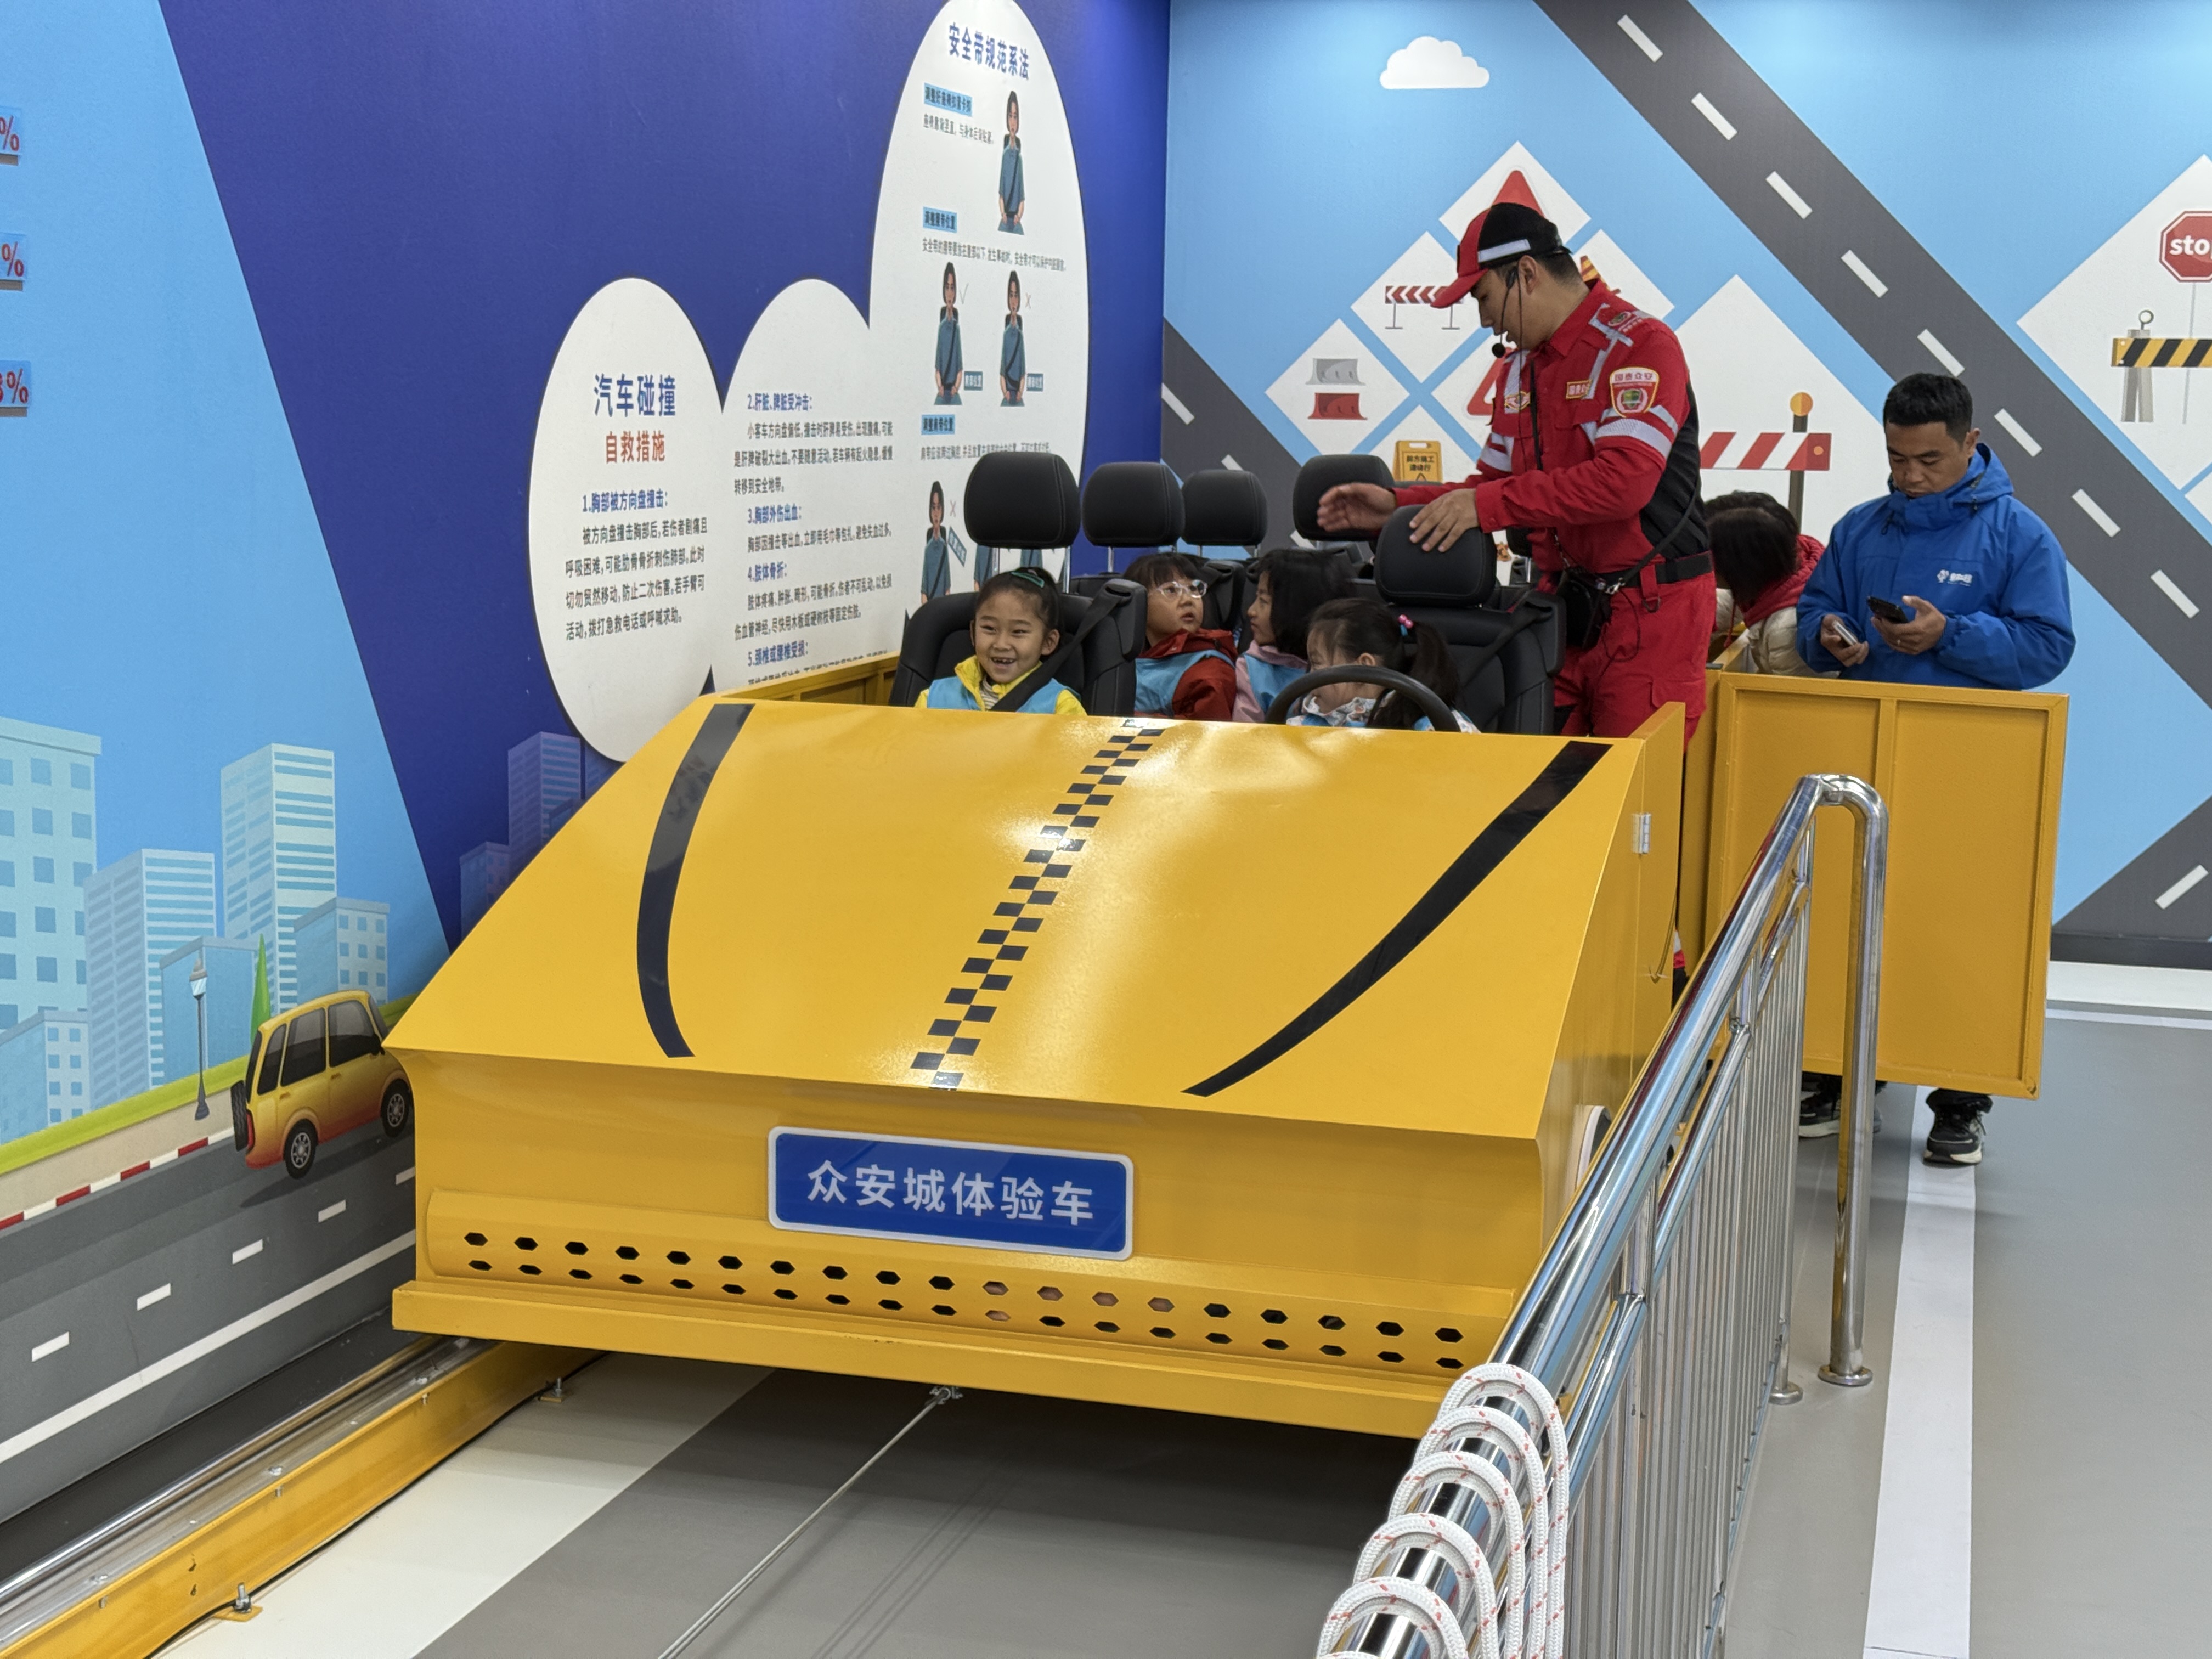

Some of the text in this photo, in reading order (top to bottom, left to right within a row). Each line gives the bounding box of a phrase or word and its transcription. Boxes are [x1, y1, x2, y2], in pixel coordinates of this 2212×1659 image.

[949, 22, 1029, 80] 安全带规范系法
[2169, 235, 2212, 259] sto
[594, 374, 676, 417] 汽车碰撞
[606, 431, 665, 464] 自救措施
[807, 1159, 1093, 1226] 众安城体验车
